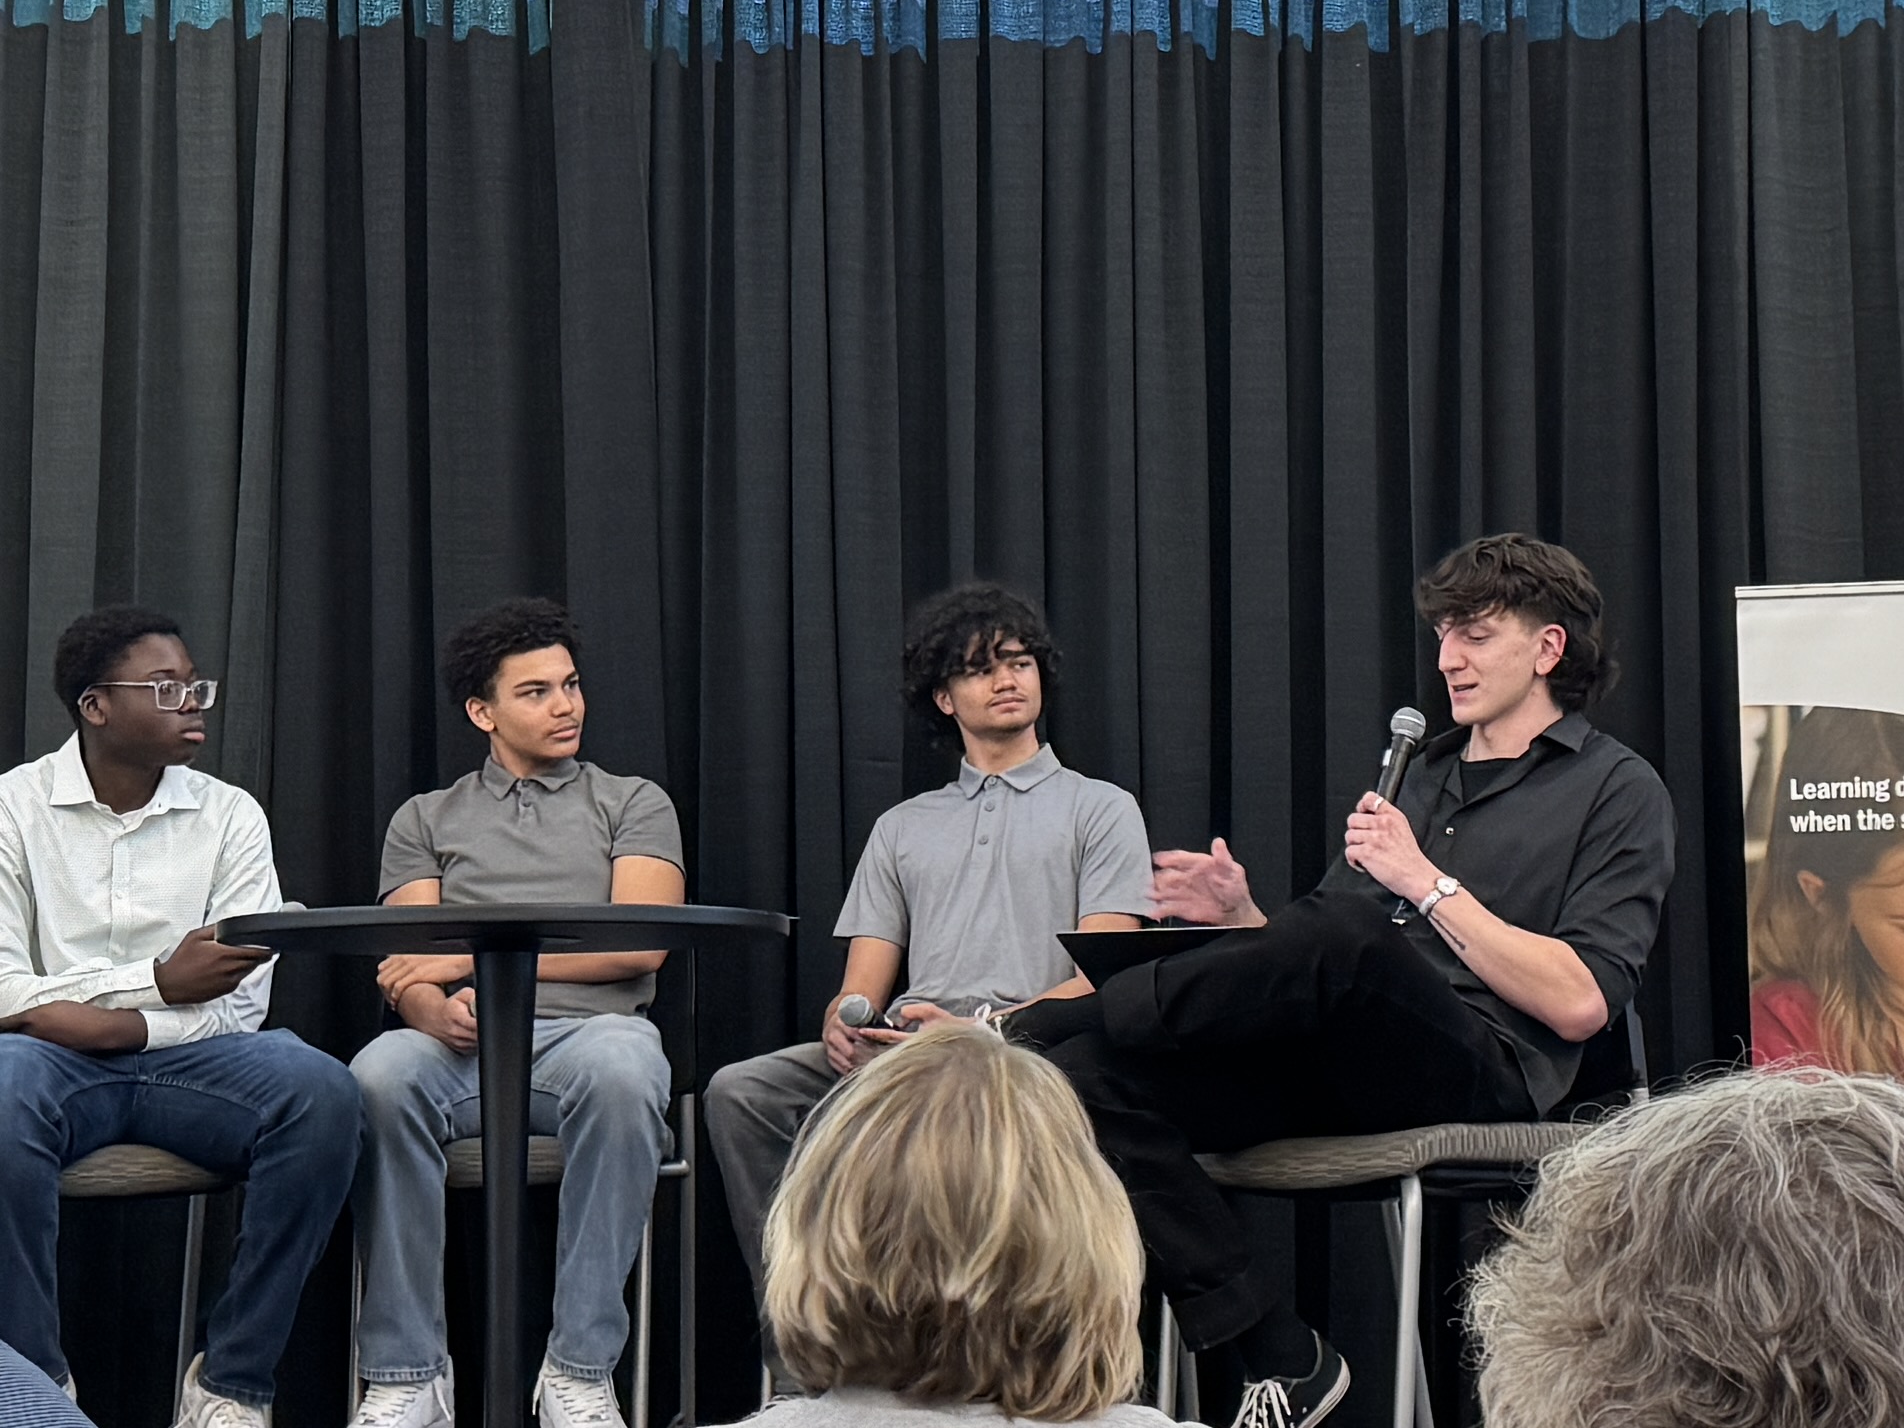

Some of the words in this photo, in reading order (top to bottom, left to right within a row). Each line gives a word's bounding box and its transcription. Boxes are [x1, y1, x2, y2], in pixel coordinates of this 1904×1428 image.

[1790, 776, 1890, 802] Learning
[1790, 810, 1851, 833] when
[1857, 809, 1895, 830] the
